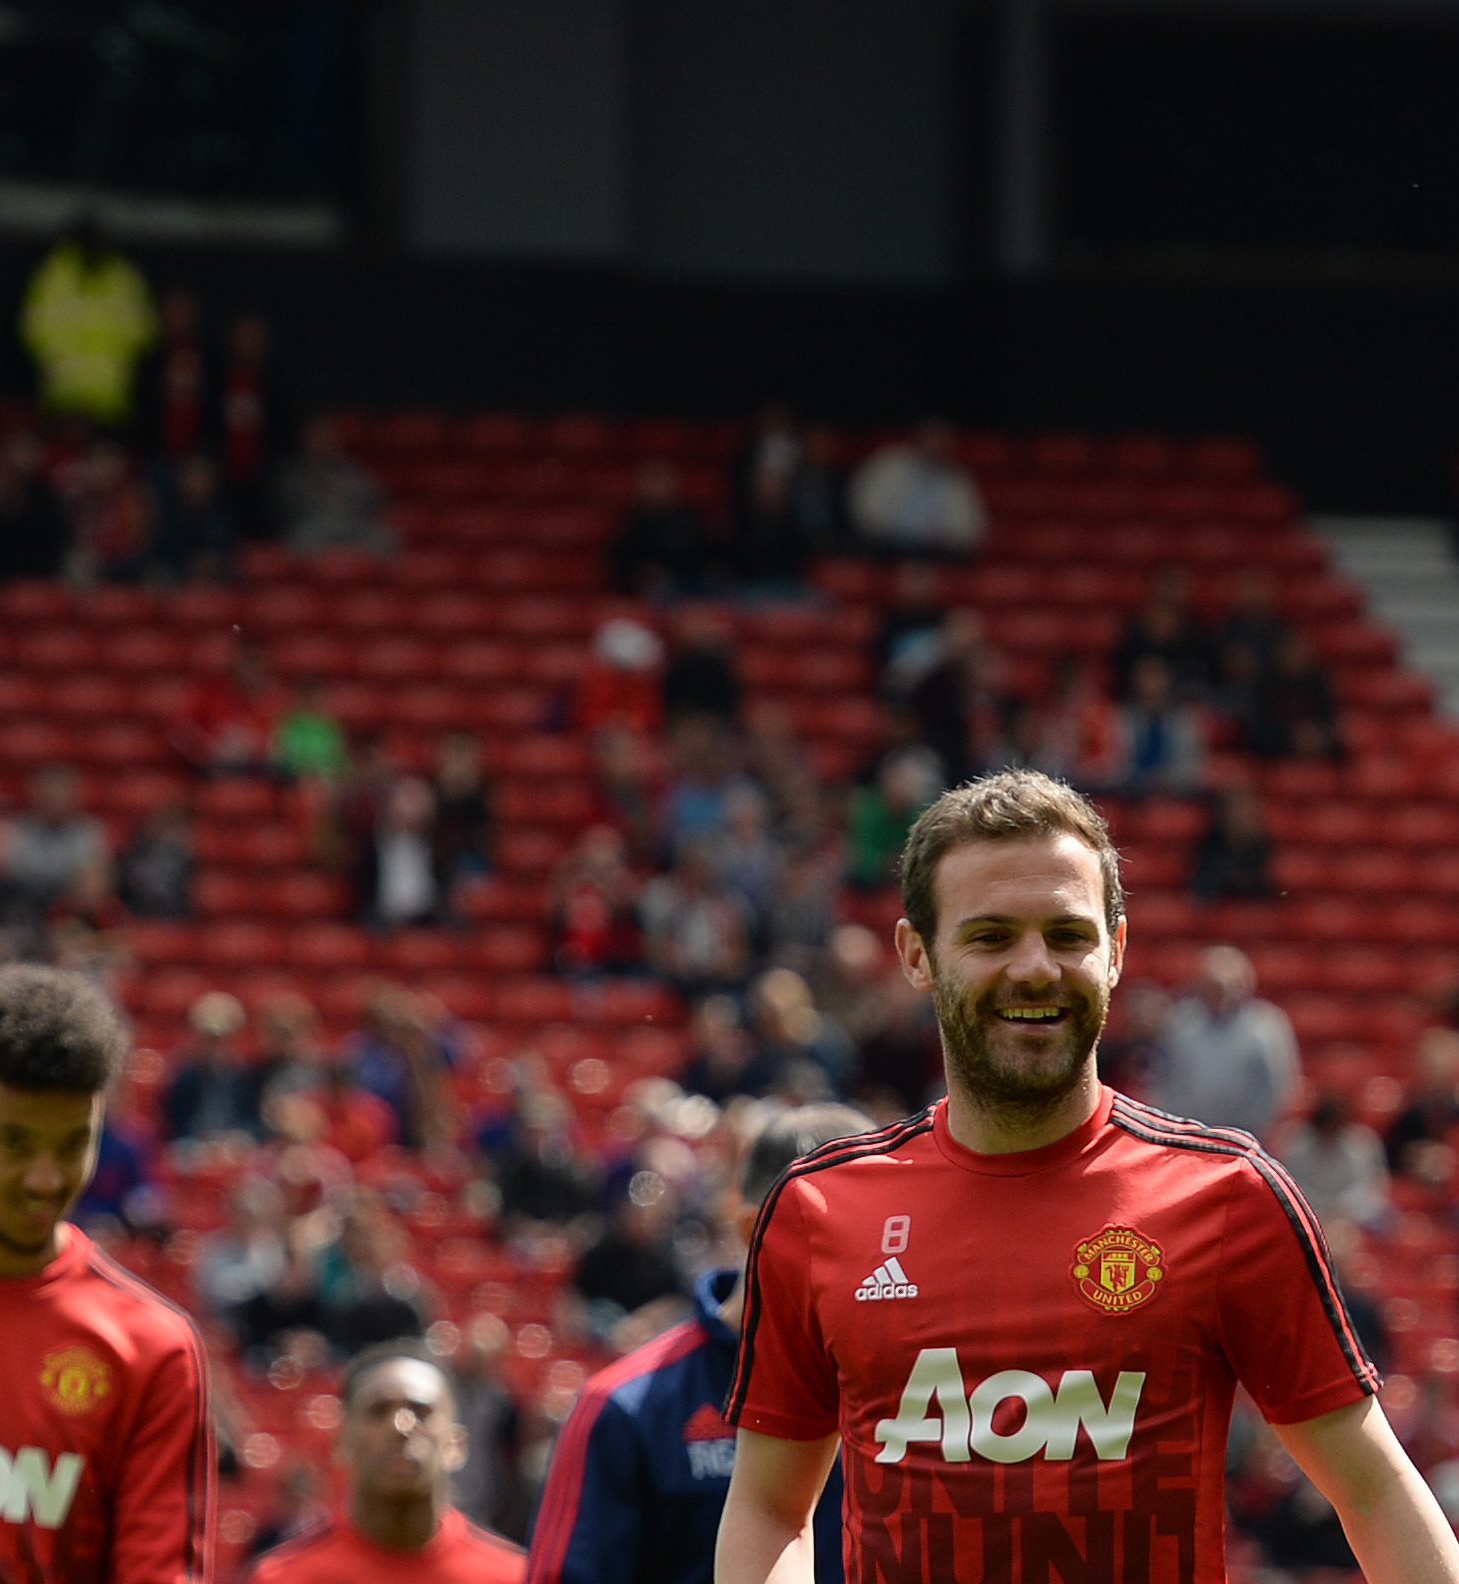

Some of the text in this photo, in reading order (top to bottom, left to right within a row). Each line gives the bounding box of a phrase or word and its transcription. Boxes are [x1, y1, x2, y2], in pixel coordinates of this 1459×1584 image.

[881, 1214, 911, 1254] 8
[1083, 1235, 1154, 1263] MANCHESTER
[854, 1283, 919, 1301] adidas
[1093, 1289, 1143, 1305] UNITED
[874, 1347, 1146, 1464] AON
